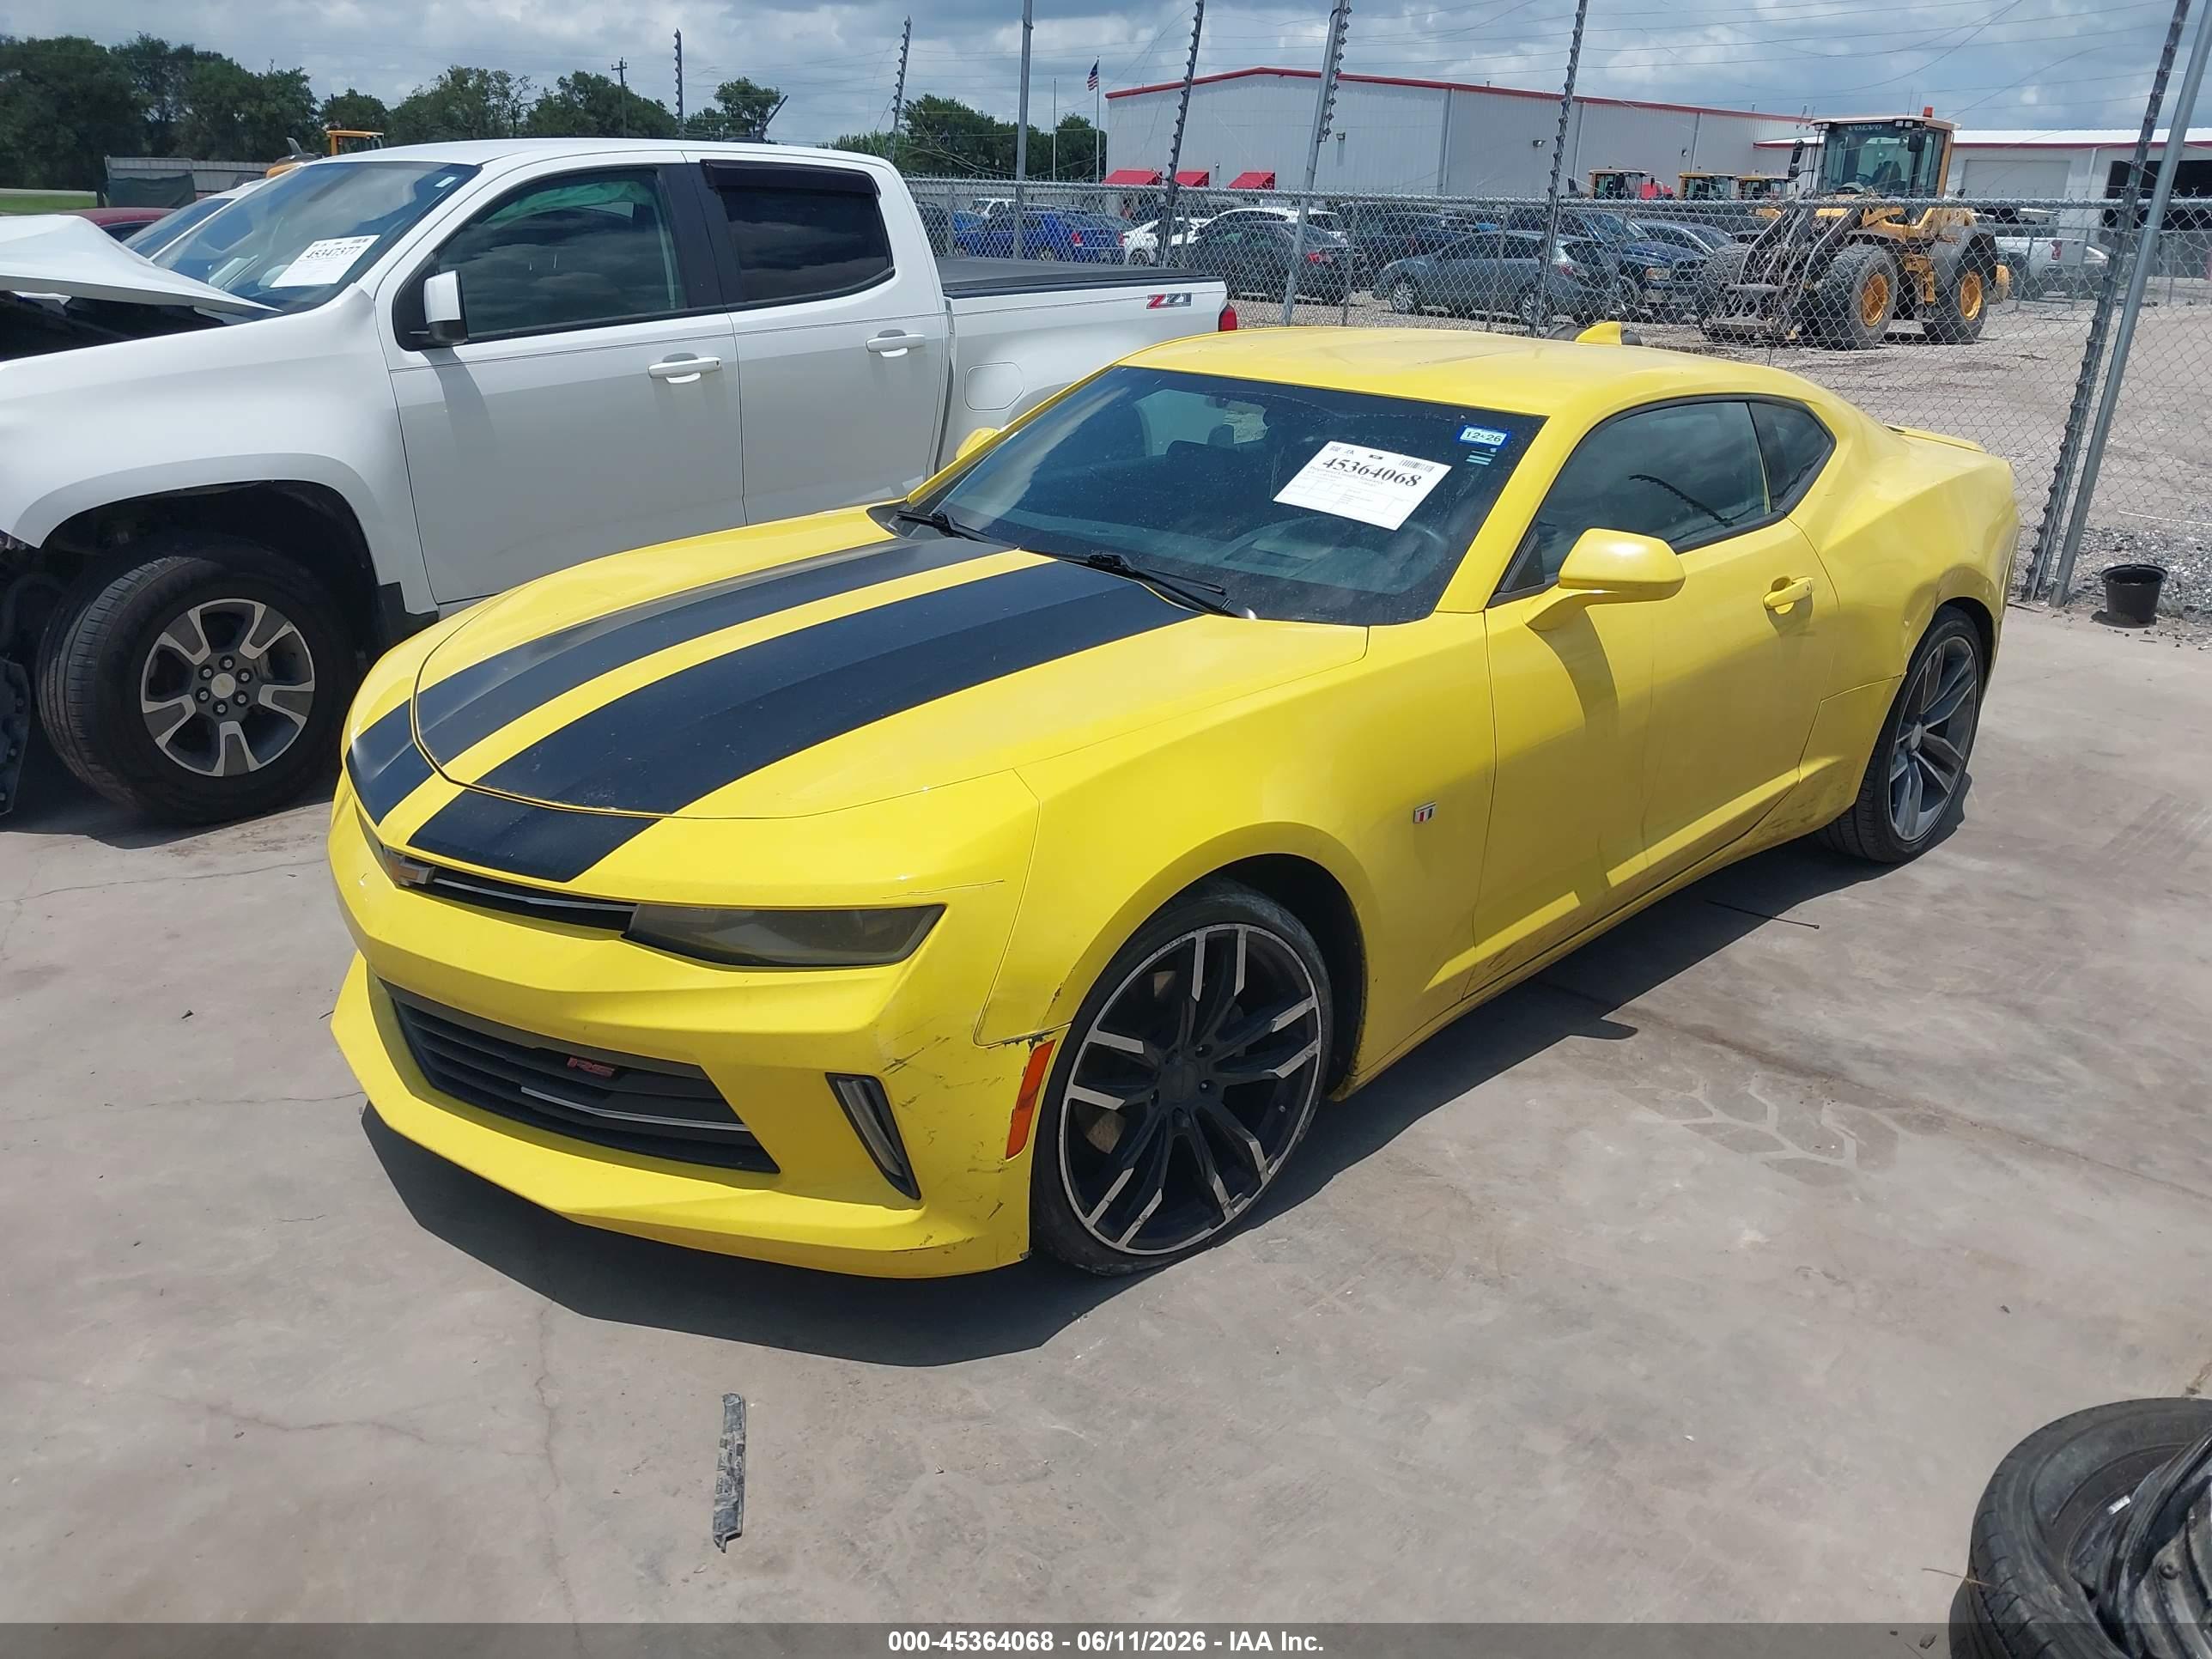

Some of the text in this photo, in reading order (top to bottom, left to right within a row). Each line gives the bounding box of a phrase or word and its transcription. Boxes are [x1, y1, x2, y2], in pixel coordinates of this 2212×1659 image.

[1146, 293, 1192, 309] Z71
[1322, 457, 1422, 487] 45364068
[567, 1057, 615, 1078] RS
